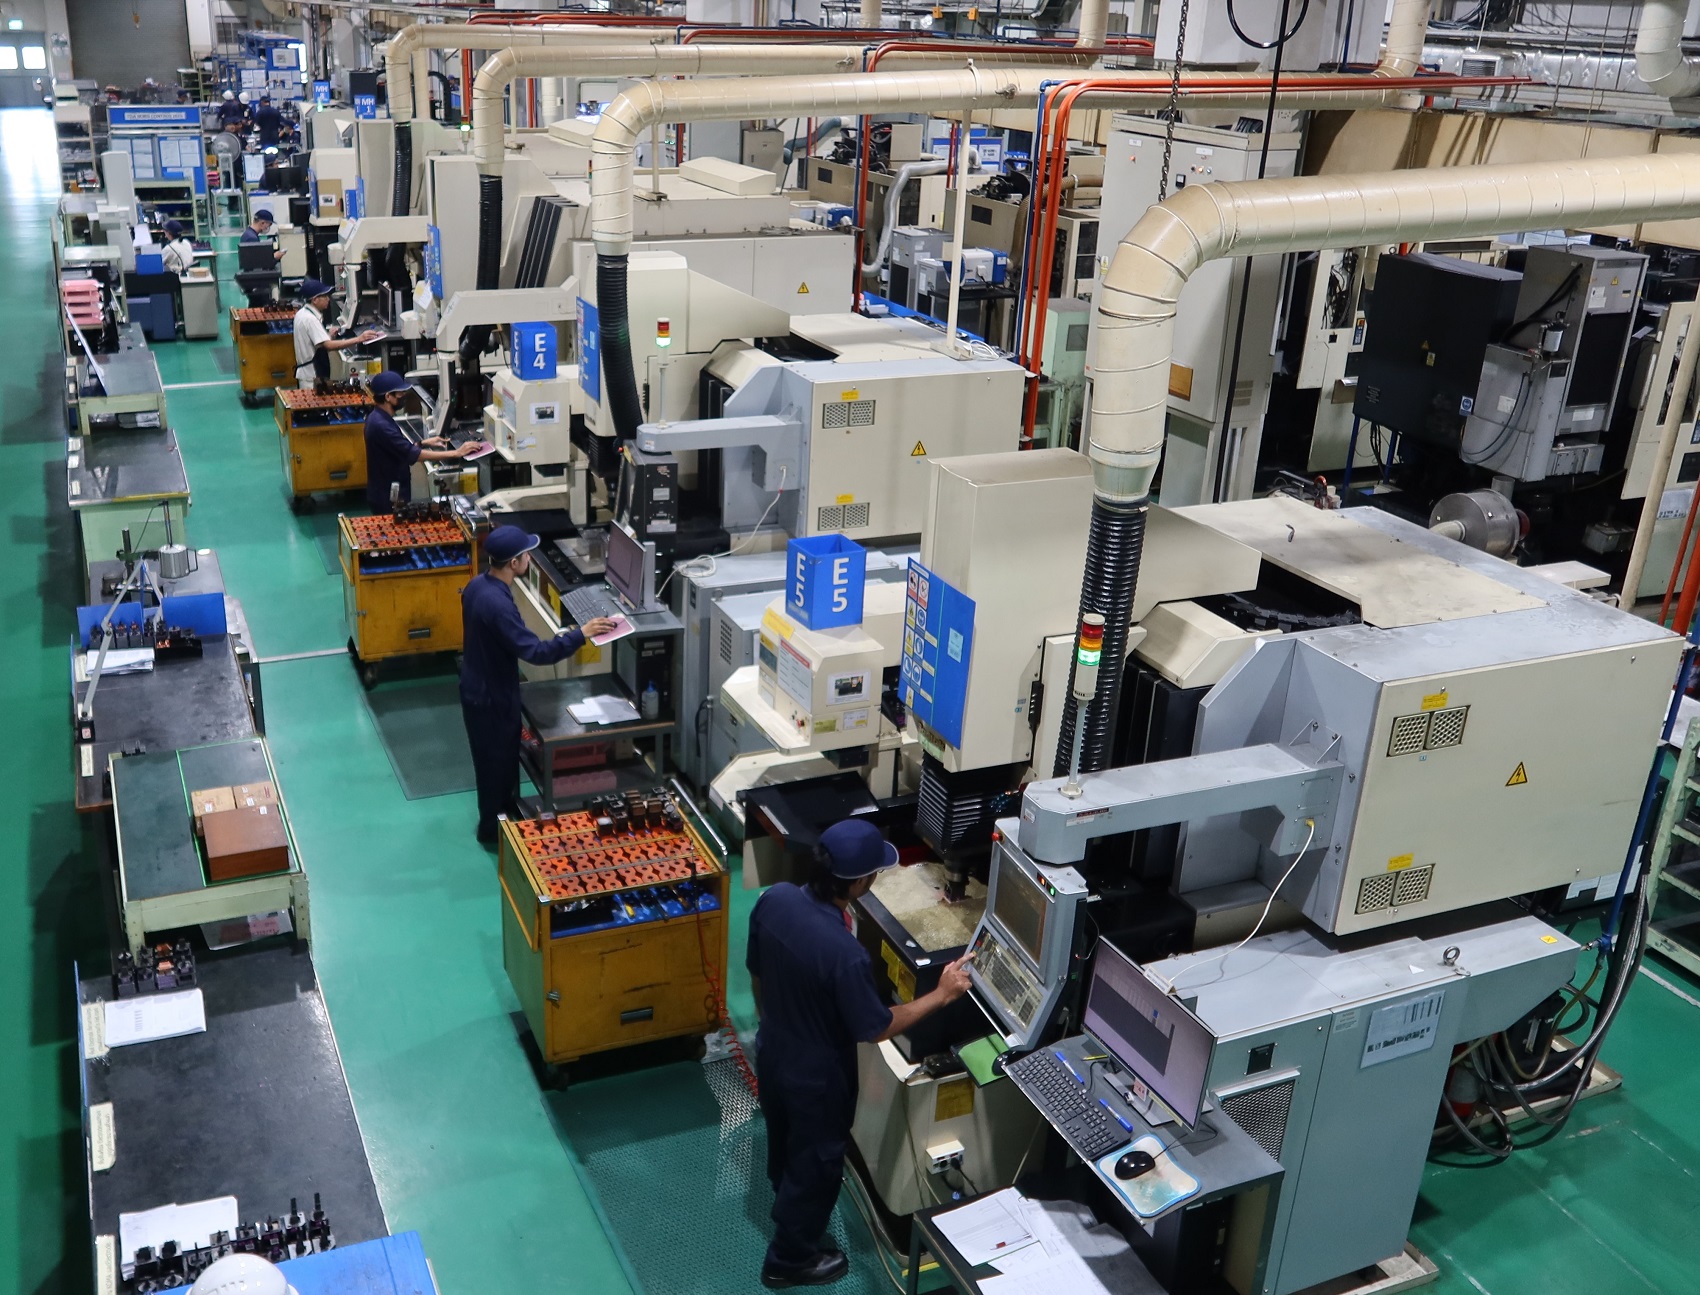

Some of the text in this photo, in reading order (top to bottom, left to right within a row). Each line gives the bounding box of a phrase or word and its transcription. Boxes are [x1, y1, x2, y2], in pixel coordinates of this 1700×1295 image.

[534, 333, 547, 353] E
[533, 353, 546, 370] 4
[796, 552, 806, 583] E
[833, 557, 849, 586] E
[795, 582, 805, 608] 5
[831, 588, 848, 613] 5
